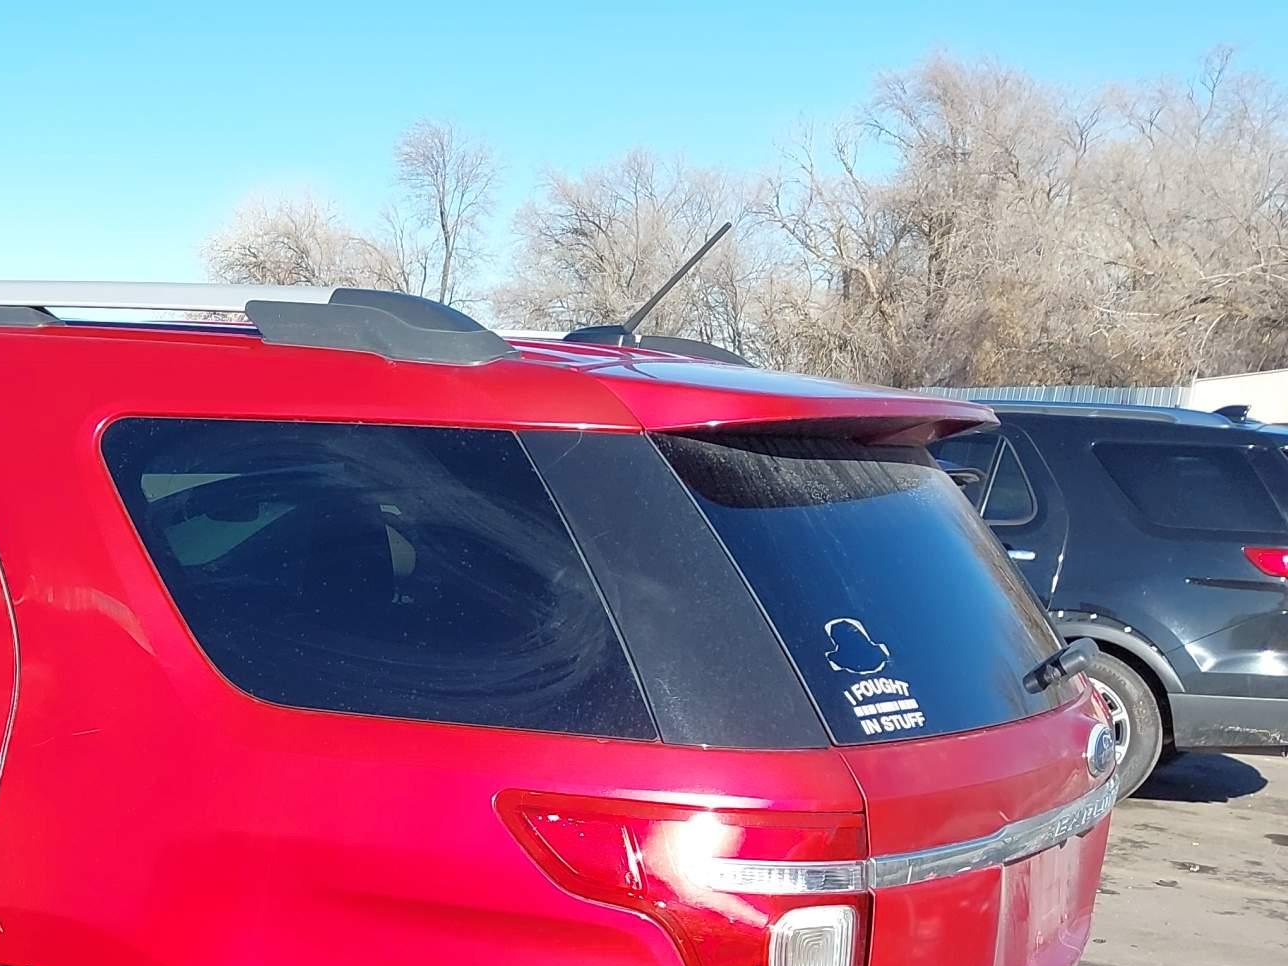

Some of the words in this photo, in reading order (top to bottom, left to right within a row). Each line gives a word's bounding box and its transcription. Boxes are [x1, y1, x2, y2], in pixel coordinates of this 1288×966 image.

[843, 690, 857, 706] I
[850, 677, 910, 701] FOUGHT
[860, 718, 882, 736] IN
[880, 711, 926, 732] STUFF
[1055, 774, 1120, 837] EXPL
